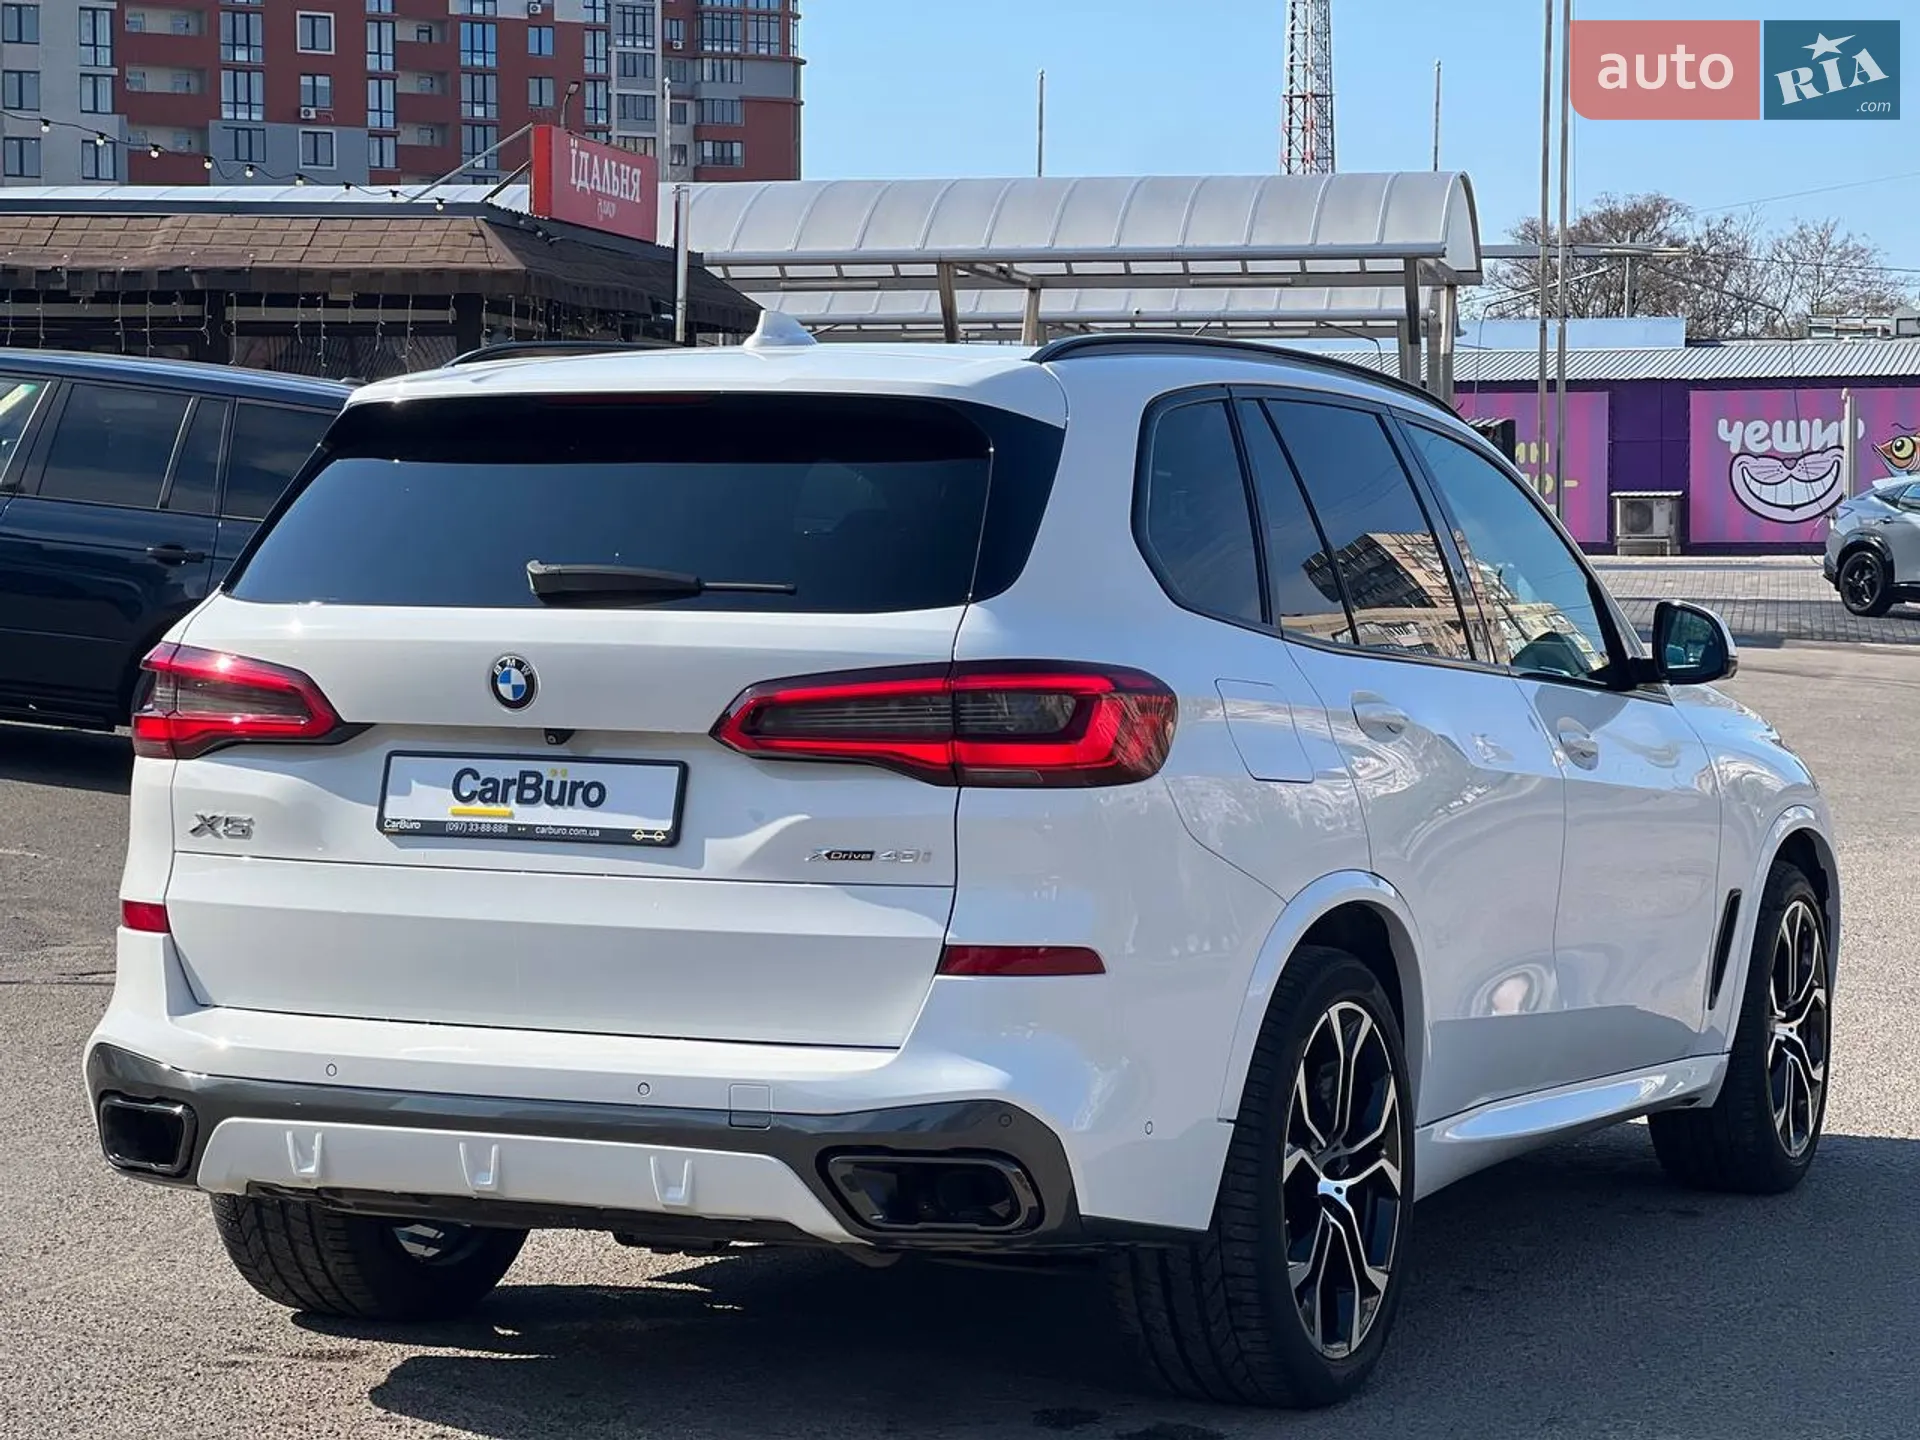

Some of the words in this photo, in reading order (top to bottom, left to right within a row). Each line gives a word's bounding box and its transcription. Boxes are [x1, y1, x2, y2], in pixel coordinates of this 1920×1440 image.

[570, 138, 641, 203] ЇДАЛЬНЯ
[452, 767, 606, 808] CarBüro
[189, 812, 255, 840] X5
[445, 822, 467, 833] (097)
